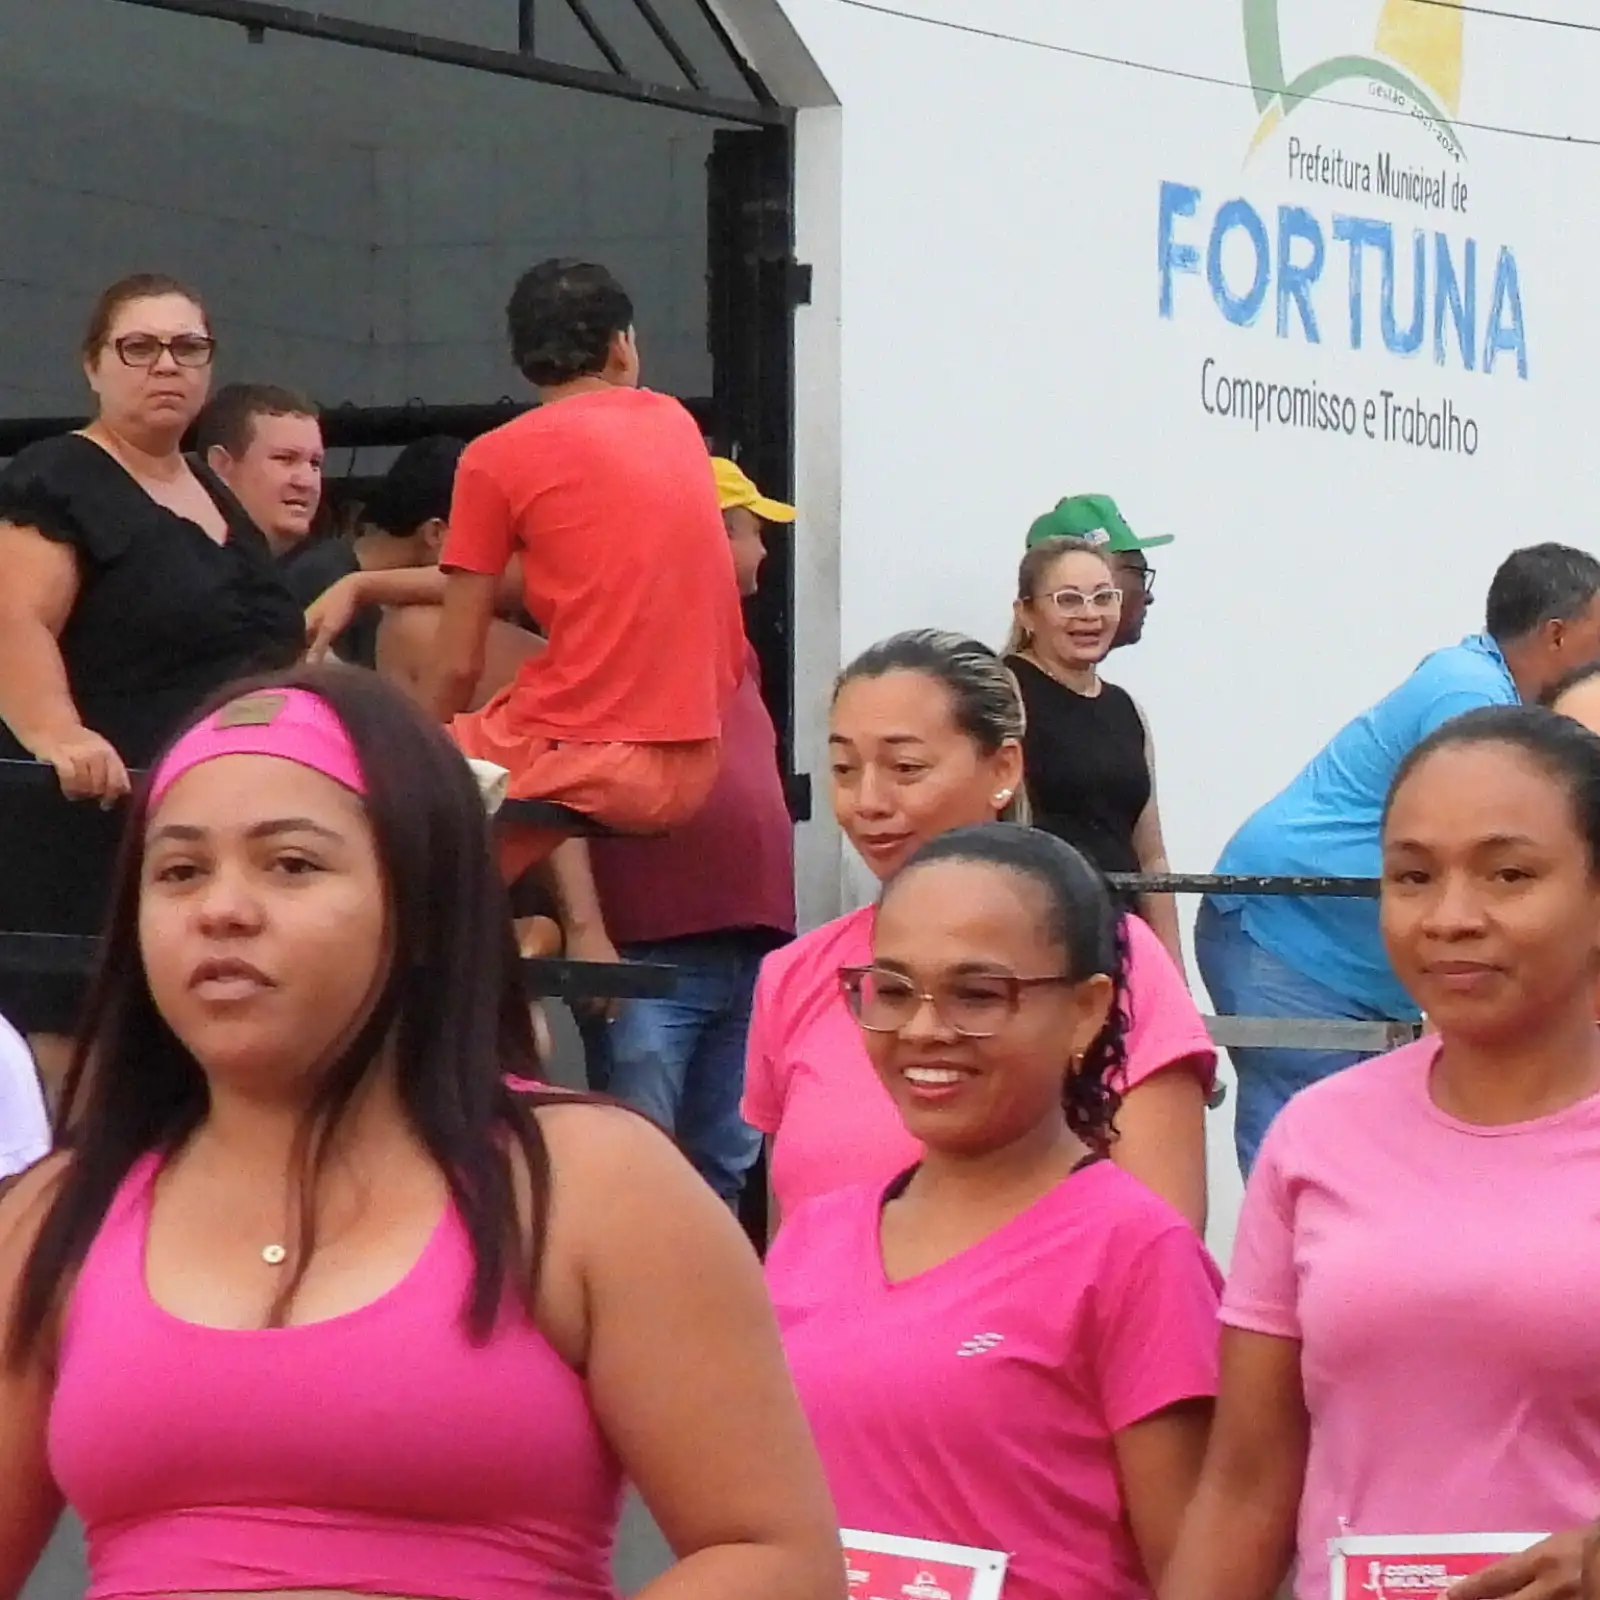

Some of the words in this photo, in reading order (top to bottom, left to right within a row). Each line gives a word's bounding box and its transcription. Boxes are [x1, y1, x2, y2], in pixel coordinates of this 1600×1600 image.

[1289, 136, 1370, 192] Prefeitura
[1377, 152, 1446, 210] Municipal
[1451, 173, 1468, 213] de
[1157, 179, 1529, 381] FORTUNA
[1201, 357, 1356, 435] Compromisso
[1363, 398, 1376, 439] e
[1379, 389, 1479, 456] Trabalho
